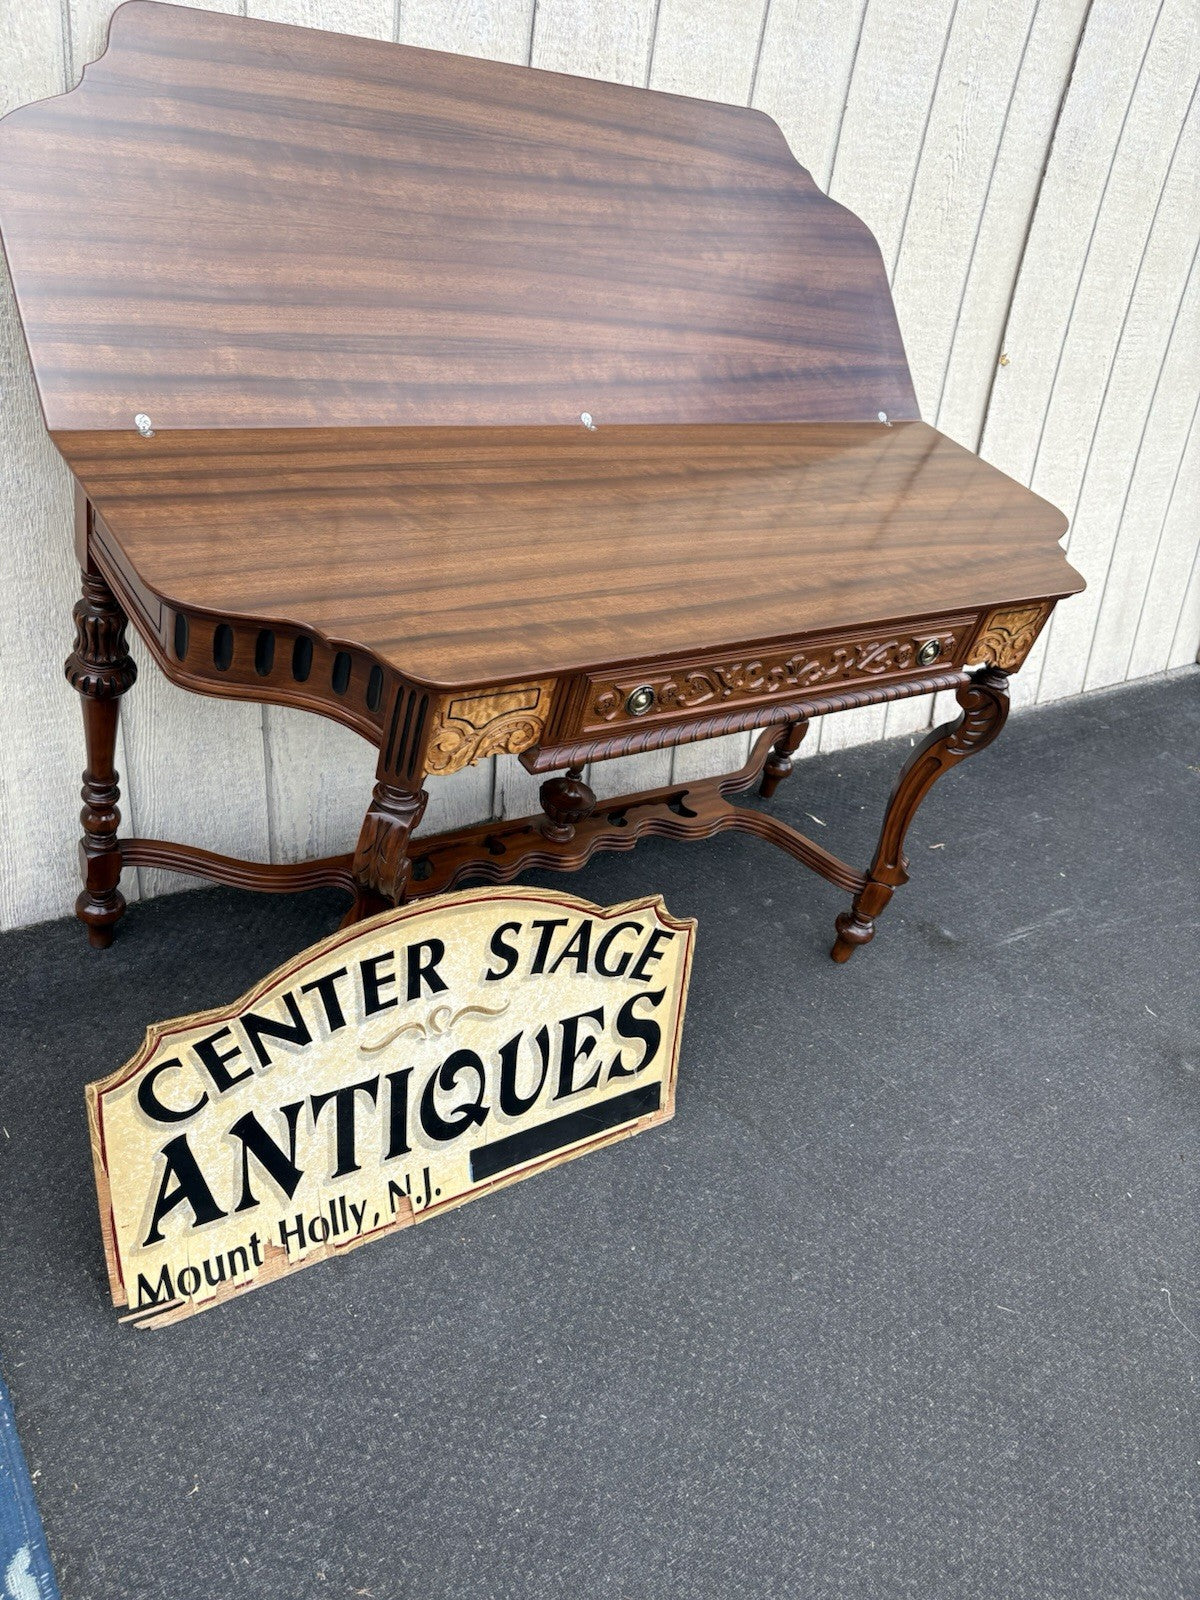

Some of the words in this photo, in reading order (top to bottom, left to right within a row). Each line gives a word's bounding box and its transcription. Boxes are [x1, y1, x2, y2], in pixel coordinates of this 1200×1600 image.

[137, 938, 448, 1124] CENTER
[485, 919, 675, 982] STAGE
[142, 987, 667, 1248] ANTIQUES
[137, 1232, 264, 1307] Mount
[278, 1196, 381, 1253] Holly,
[388, 1167, 442, 1214] N.J.
